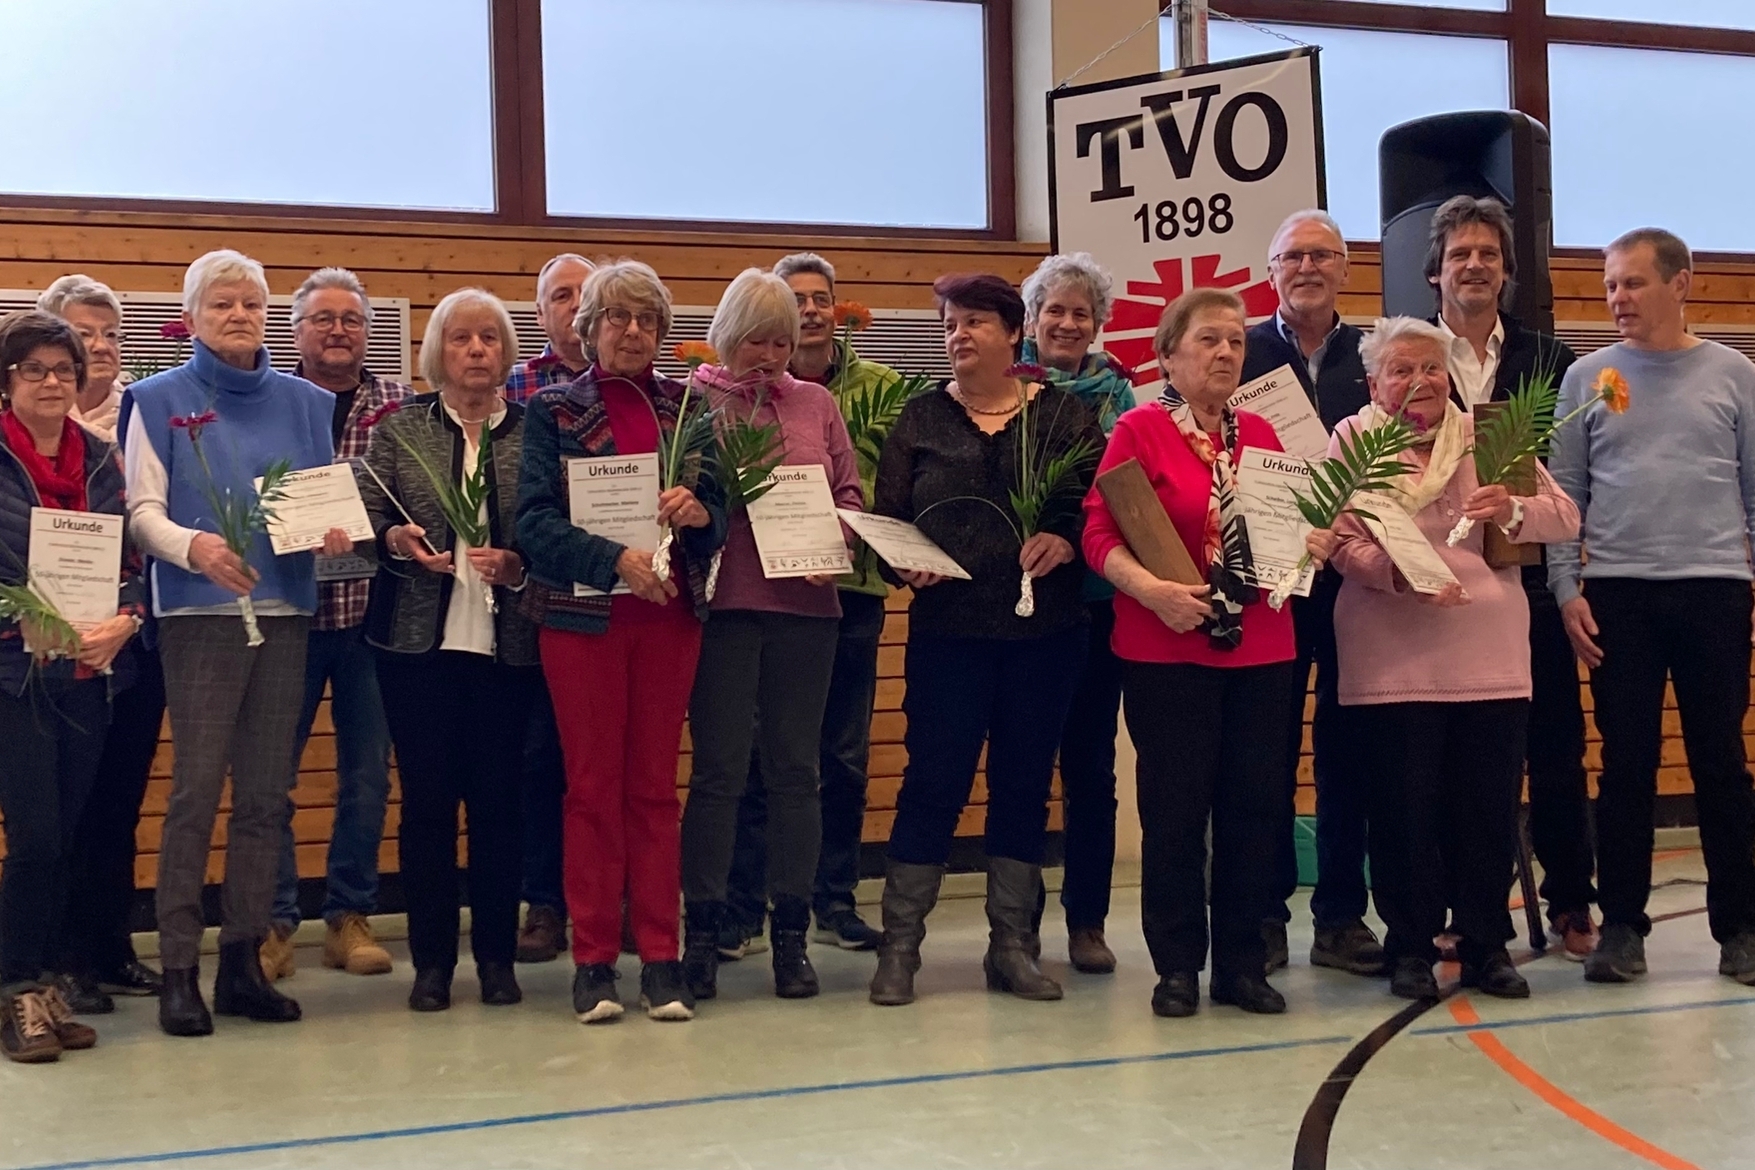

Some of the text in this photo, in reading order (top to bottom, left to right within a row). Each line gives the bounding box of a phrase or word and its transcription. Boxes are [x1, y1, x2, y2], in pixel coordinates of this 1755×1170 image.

[1075, 83, 1288, 203] TVO
[1133, 192, 1234, 243] 1898
[1229, 380, 1278, 407] Urkunde
[588, 463, 639, 477] Urkunde
[765, 471, 808, 482] rkunde
[52, 517, 104, 533] Urkunde
